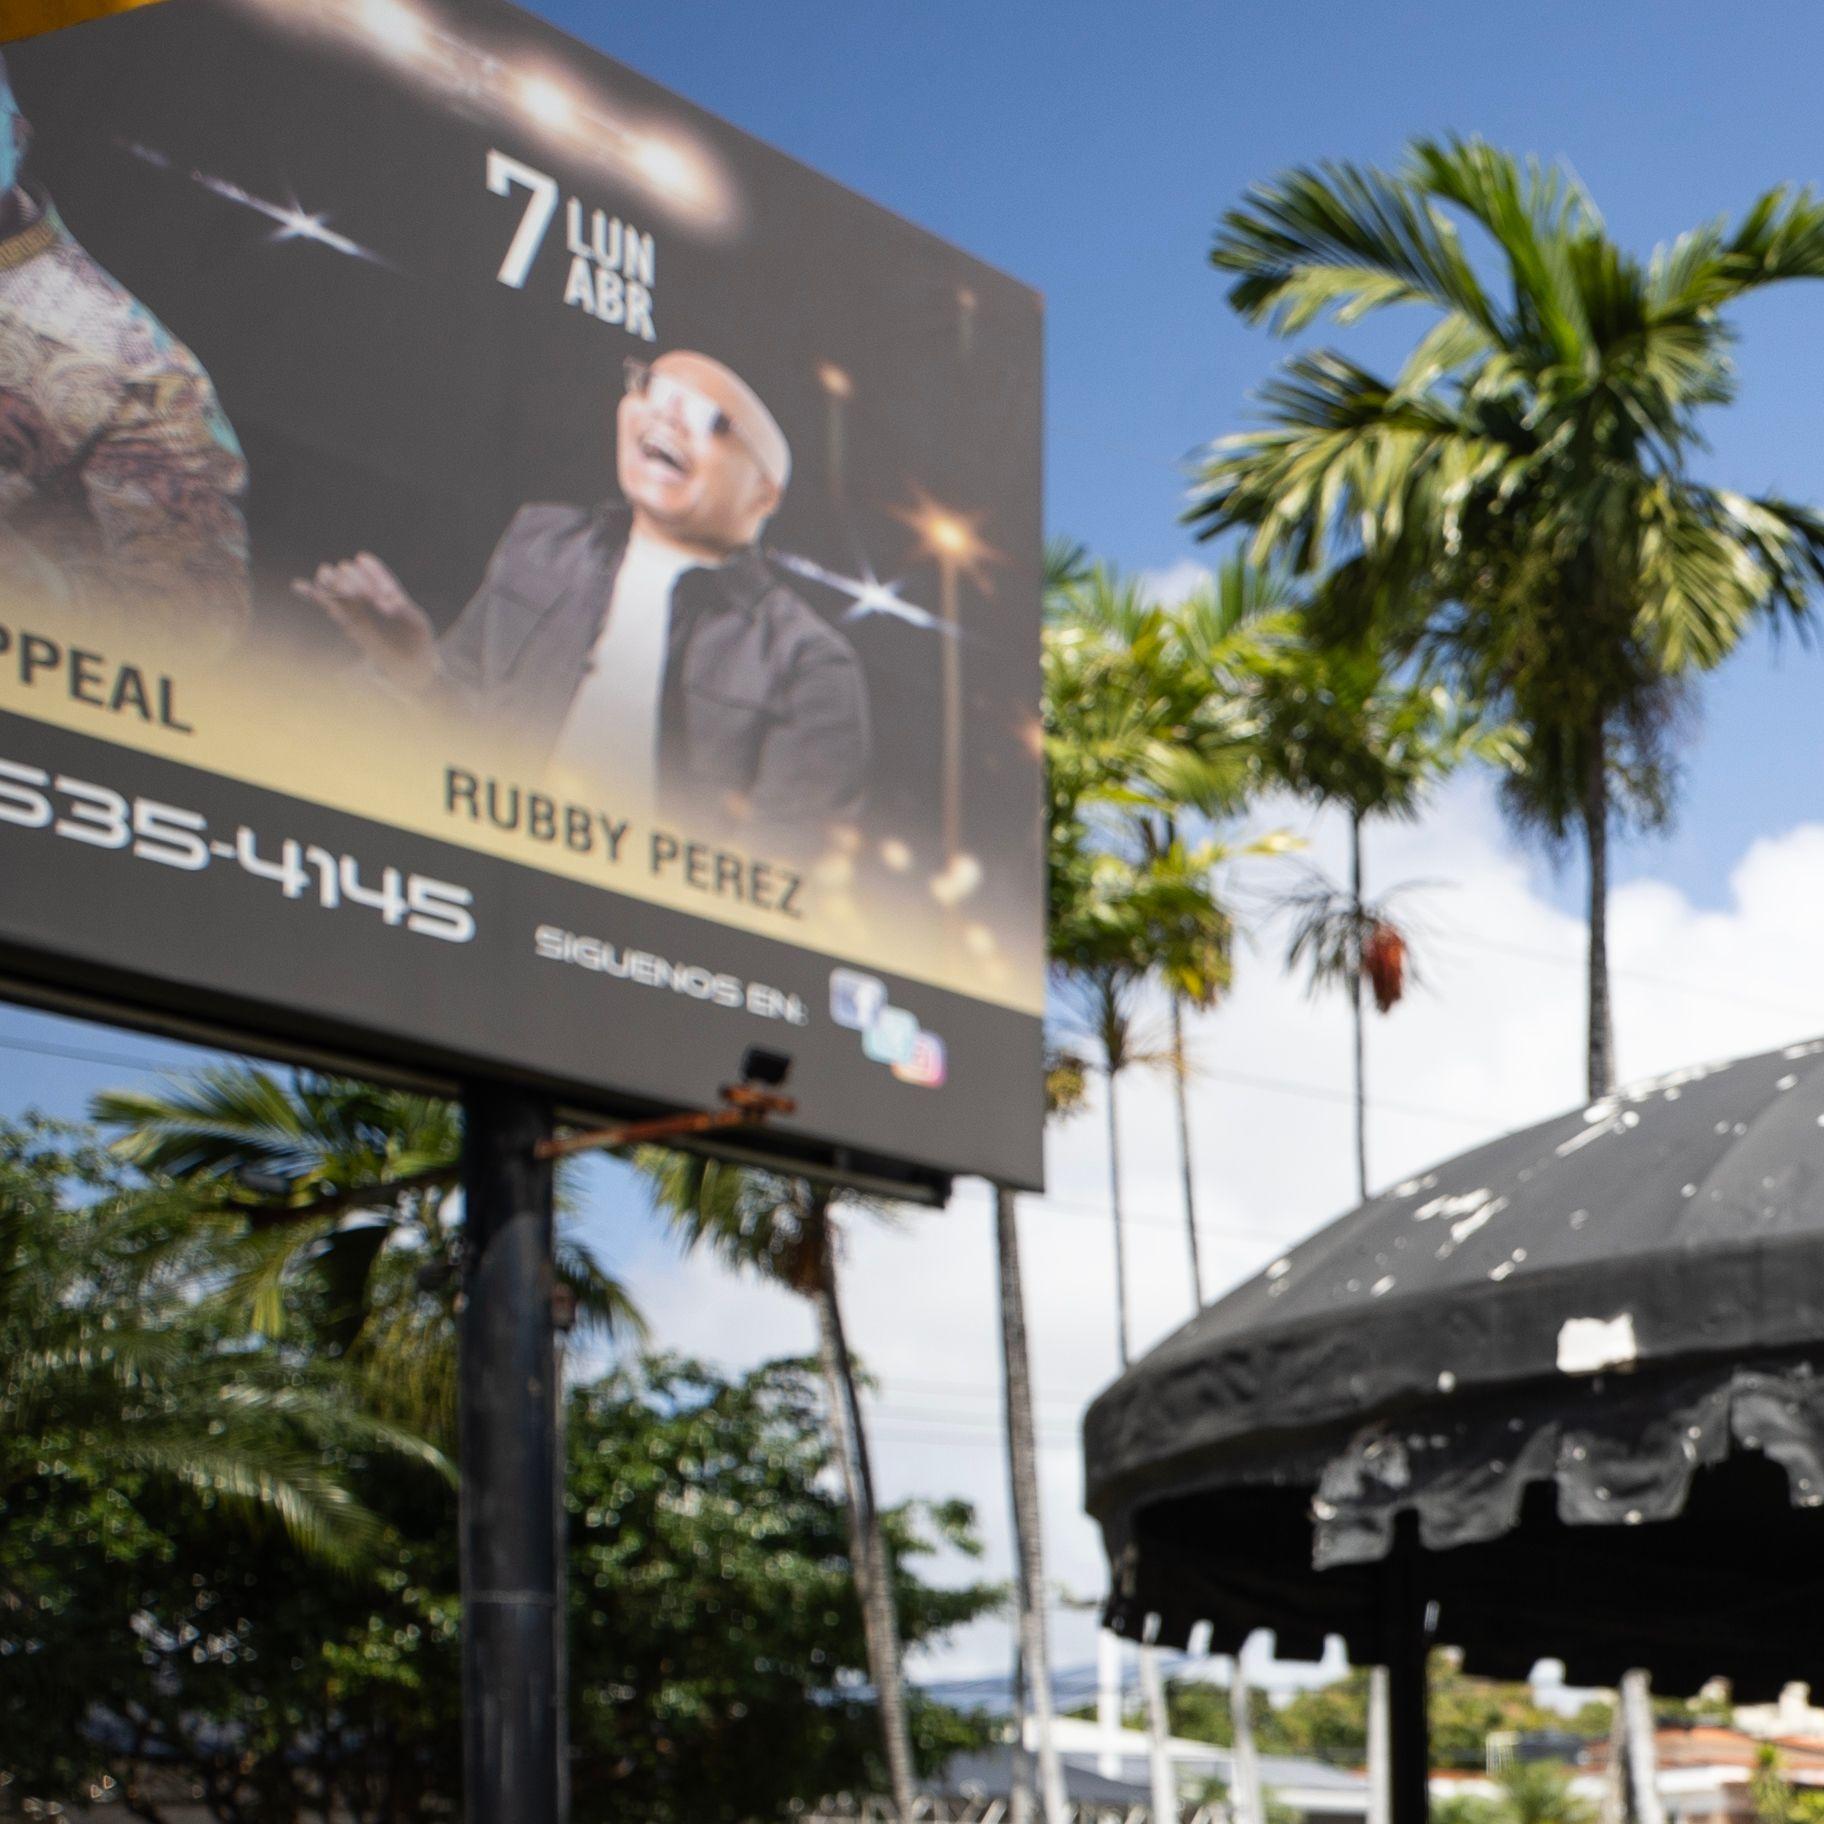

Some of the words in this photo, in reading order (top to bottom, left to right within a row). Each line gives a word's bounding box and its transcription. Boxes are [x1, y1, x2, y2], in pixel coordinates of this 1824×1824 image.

[486, 148, 560, 289] 7
[566, 196, 656, 288] LUN
[563, 256, 658, 342] ABR
[445, 766, 630, 864] RUBBY
[650, 832, 805, 919] PEREZ
[534, 923, 745, 1008] SIGUENOS
